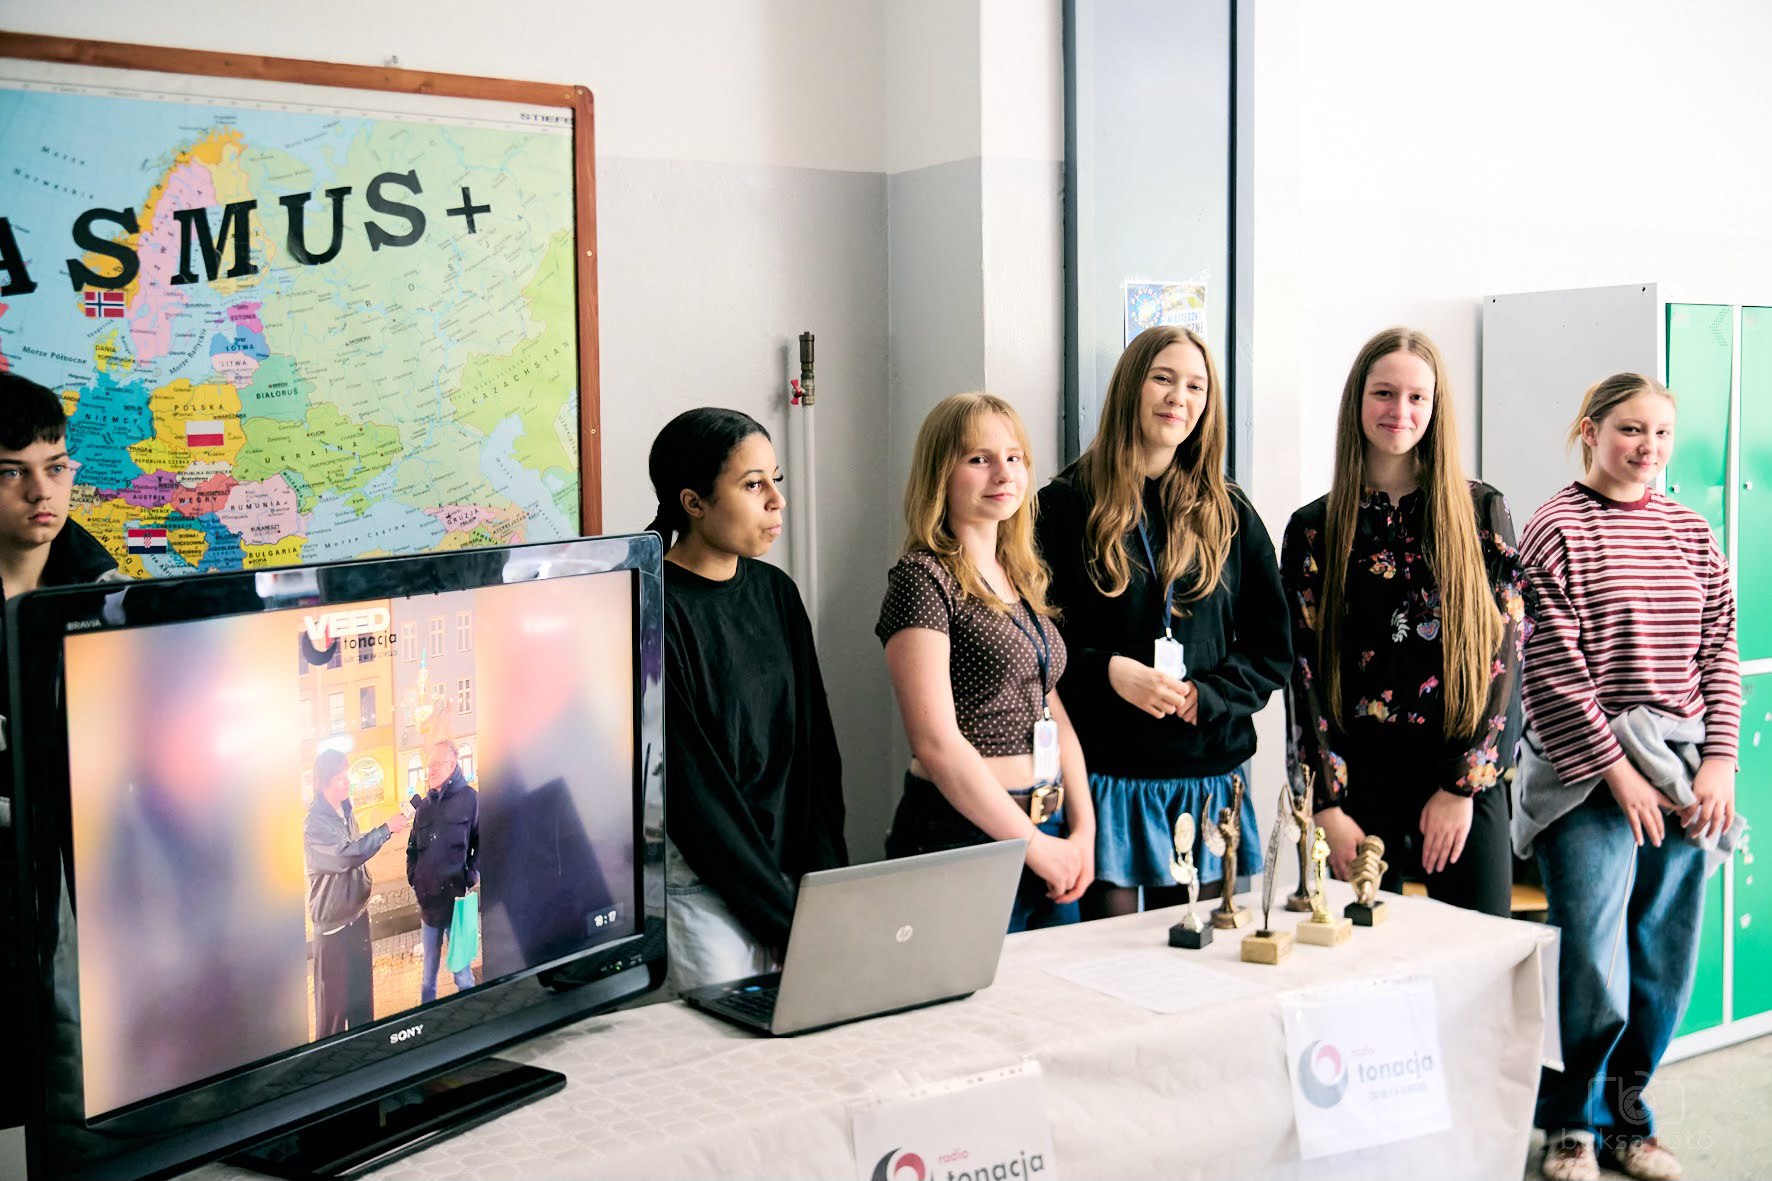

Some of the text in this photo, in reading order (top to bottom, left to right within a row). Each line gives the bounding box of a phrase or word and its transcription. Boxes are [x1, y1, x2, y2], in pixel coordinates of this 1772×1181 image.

[230, 313, 257, 321] ESTONIA
[22, 345, 48, 358] Morze
[95, 344, 117, 353] DANIA
[225, 343, 255, 352] ŁOTWA
[168, 358, 189, 376] Morze
[221, 360, 248, 368] LITWA
[255, 387, 299, 400] BIAŁORUŚ
[174, 403, 225, 412] POLSKA
[85, 412, 140, 425] NIEMCY
[264, 440, 358, 464] UKRAINA
[230, 500, 281, 511] RUMUNIA
[248, 547, 298, 559] BUŁGARIA
[67, 620, 101, 631] BRAVIA
[344, 630, 397, 650] tonacja
[390, 1024, 423, 1044] SONY
[1357, 1048, 1434, 1083] tonacja
[938, 1147, 969, 1163] radio
